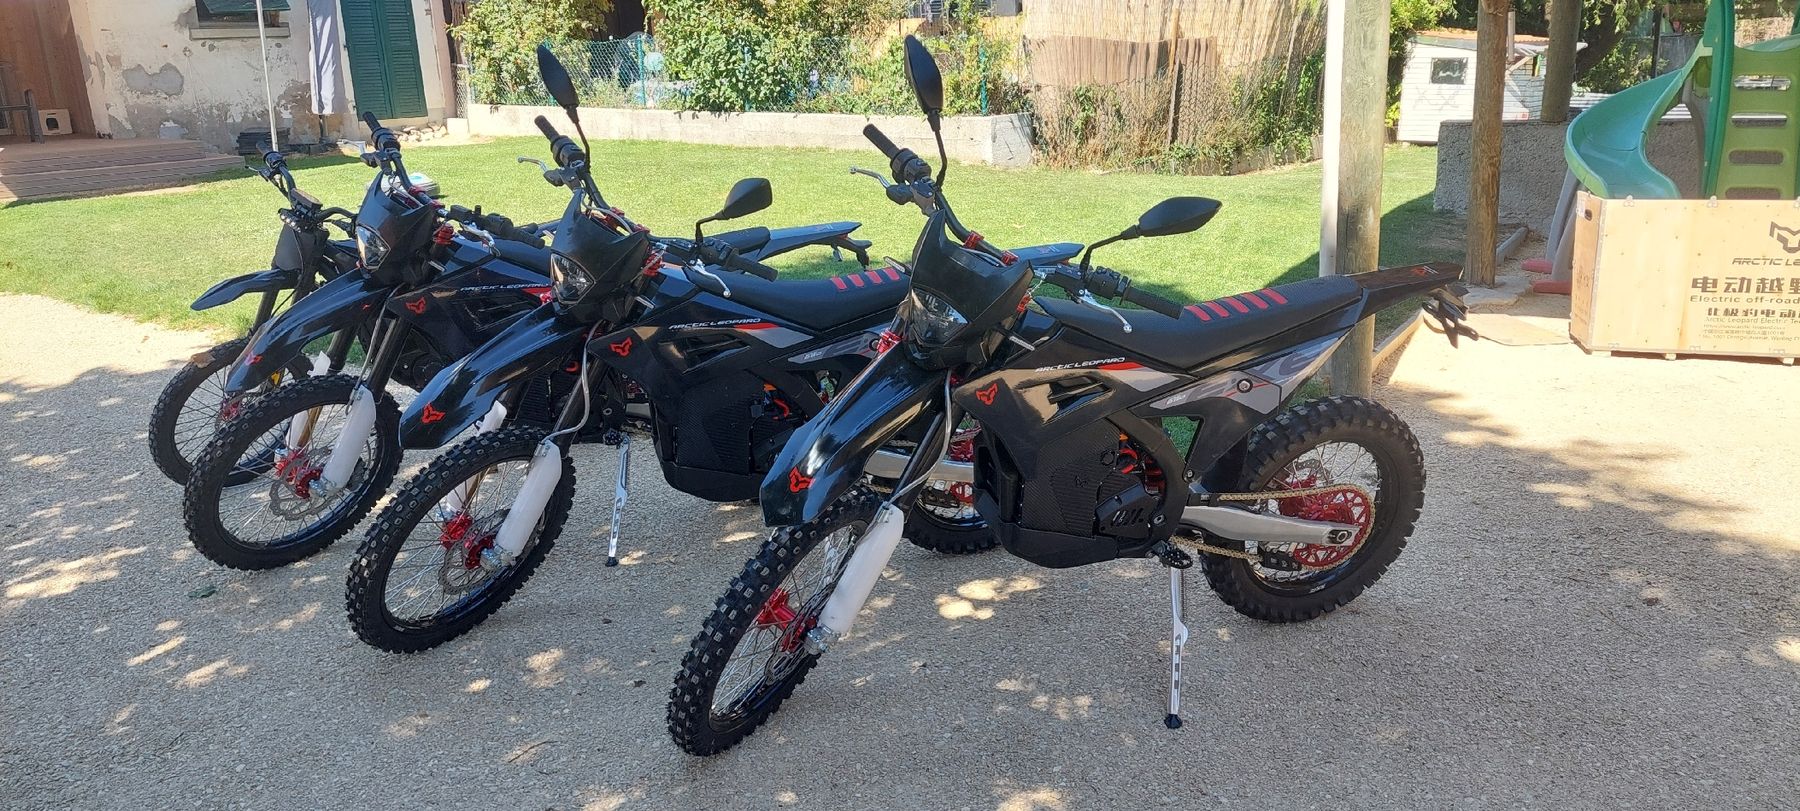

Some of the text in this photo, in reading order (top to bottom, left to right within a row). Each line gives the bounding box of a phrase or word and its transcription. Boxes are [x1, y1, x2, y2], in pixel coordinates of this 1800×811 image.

[1732, 257, 1783, 266] ARCTIC
[1690, 295, 1800, 304] Electric off-road
[1707, 307, 1800, 318] 北极豹电动
[668, 317, 761, 330] ARCTIC LEOPARD
[1035, 357, 1126, 373] ARCTIC LEOPARD
